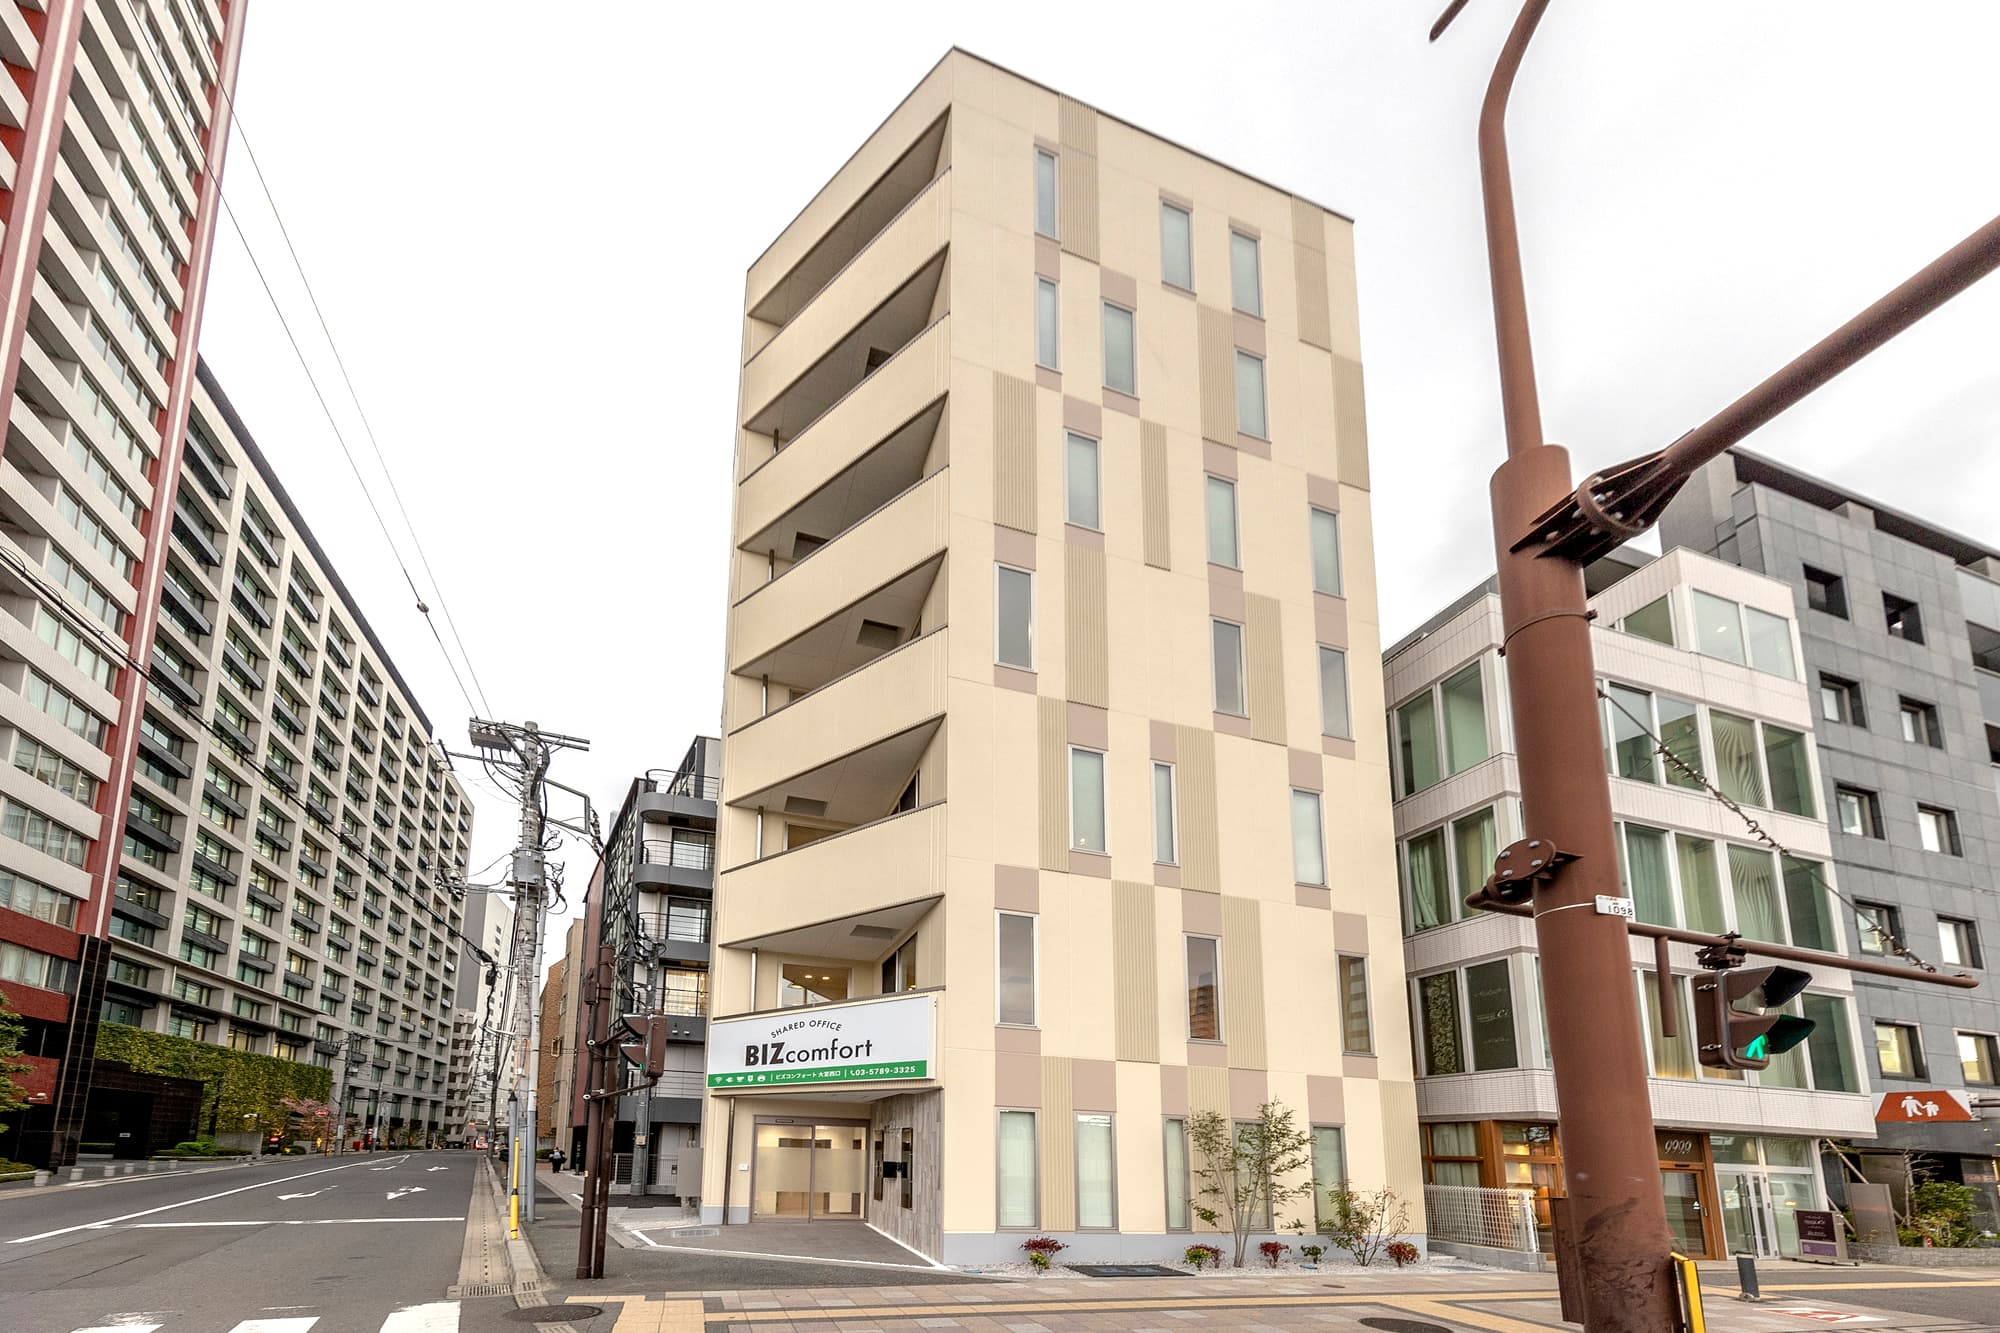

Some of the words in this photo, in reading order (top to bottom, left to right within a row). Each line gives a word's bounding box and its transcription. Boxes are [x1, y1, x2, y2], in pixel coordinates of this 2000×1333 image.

[770, 1021, 806, 1039] SHARED
[808, 1020, 843, 1032] OFFICE
[855, 1065, 916, 1076] 03-5789-3325
